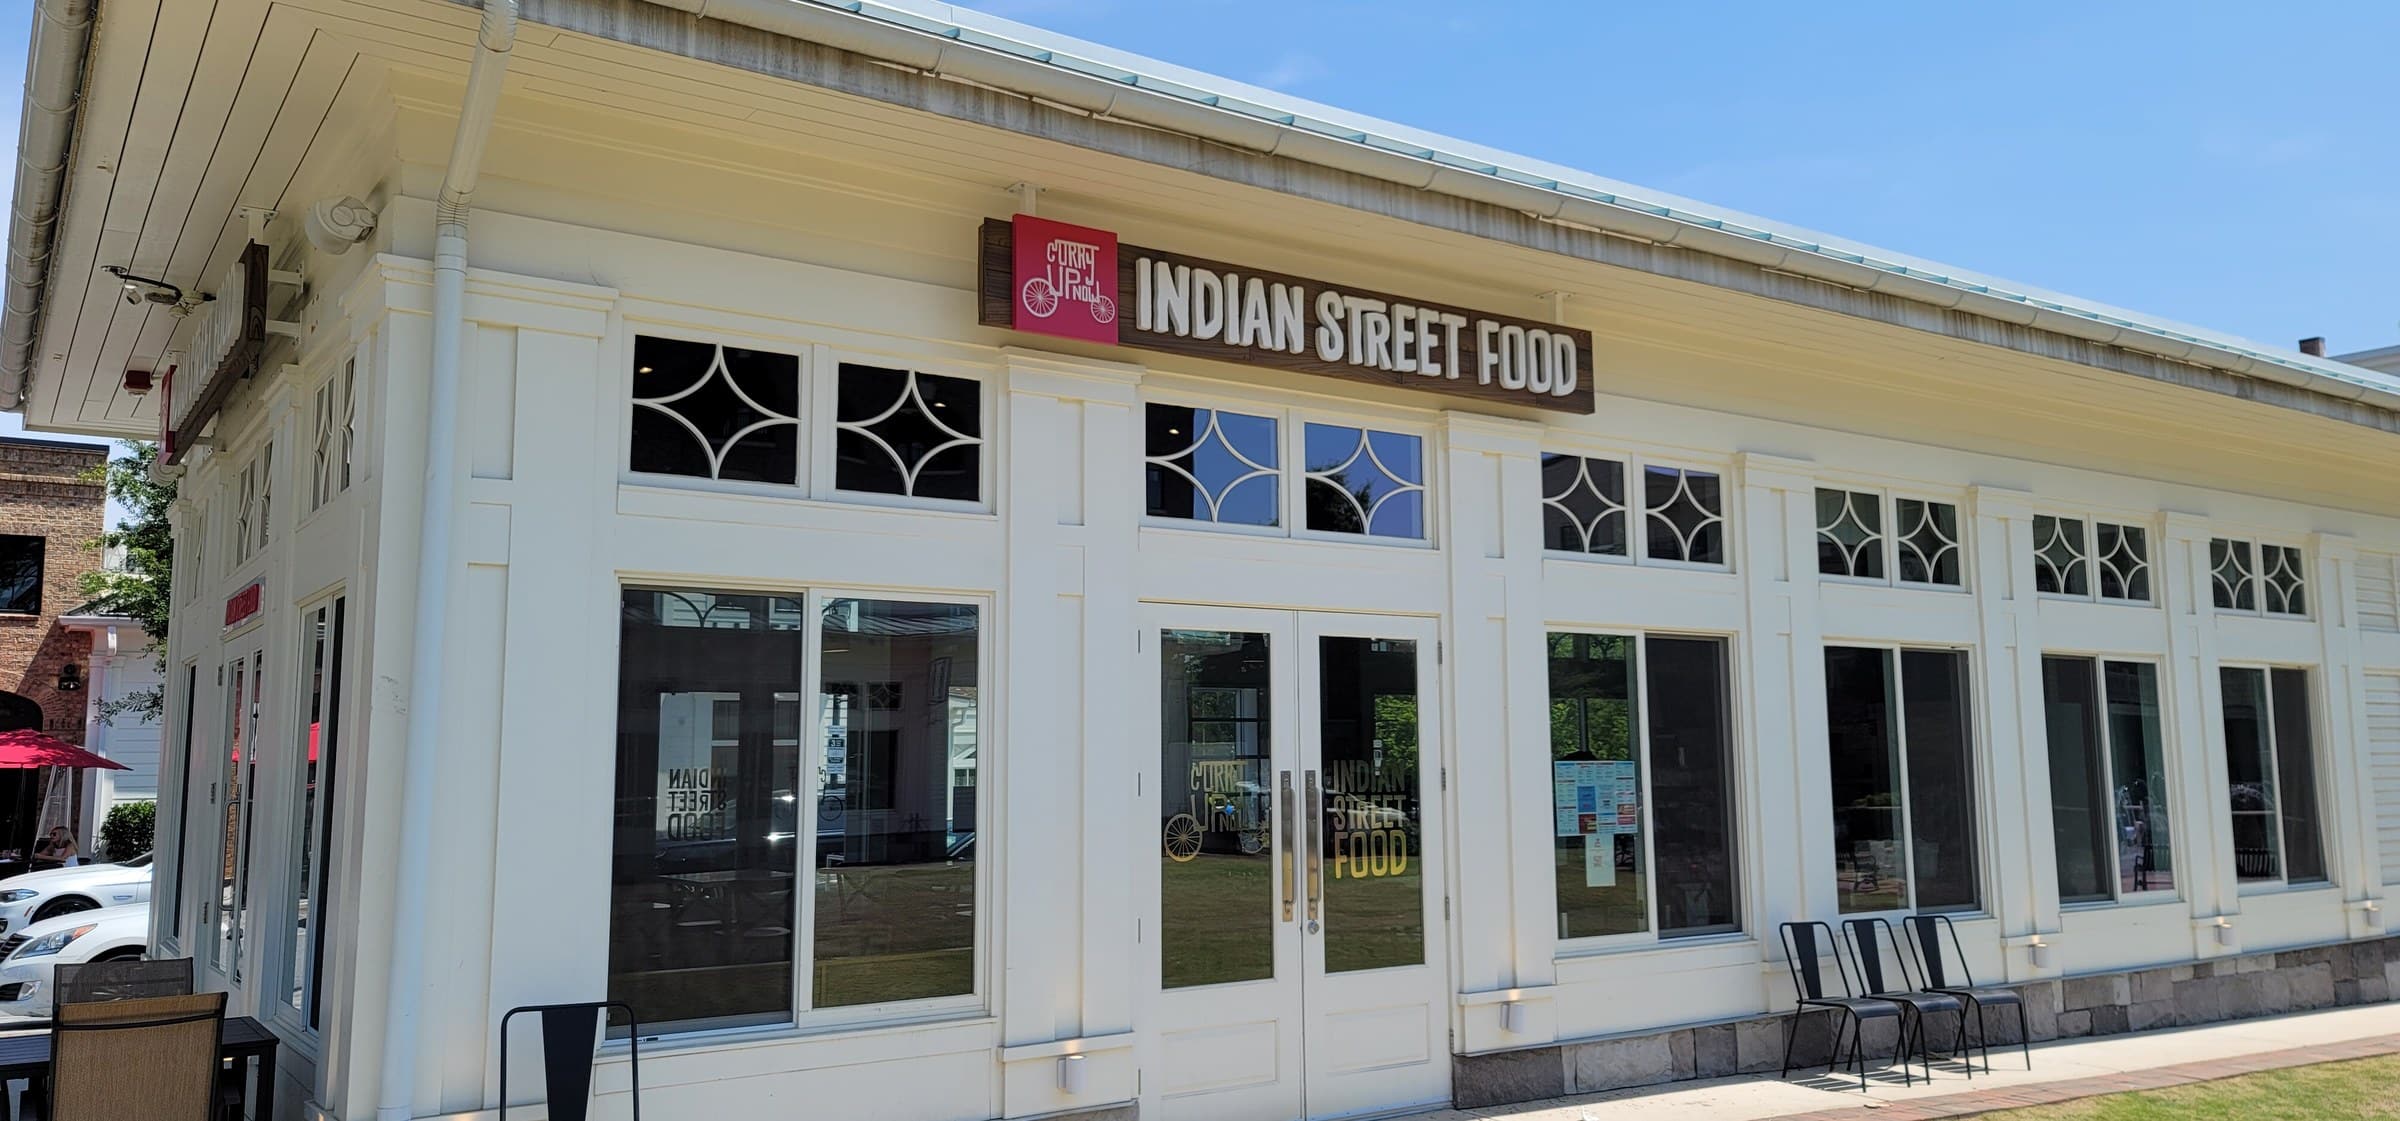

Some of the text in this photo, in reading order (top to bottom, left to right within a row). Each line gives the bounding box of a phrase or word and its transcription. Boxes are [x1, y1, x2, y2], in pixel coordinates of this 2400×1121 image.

[1047, 239, 1100, 286] CURRY
[1047, 265, 1101, 303] UP NOW
[1136, 257, 1577, 396] INDIAN STREET FOOD
[1333, 759, 1406, 793] INDIAN
[1191, 793, 1227, 832] UP
[1333, 794, 1407, 831] STREET
[1334, 829, 1408, 879] FOOD
